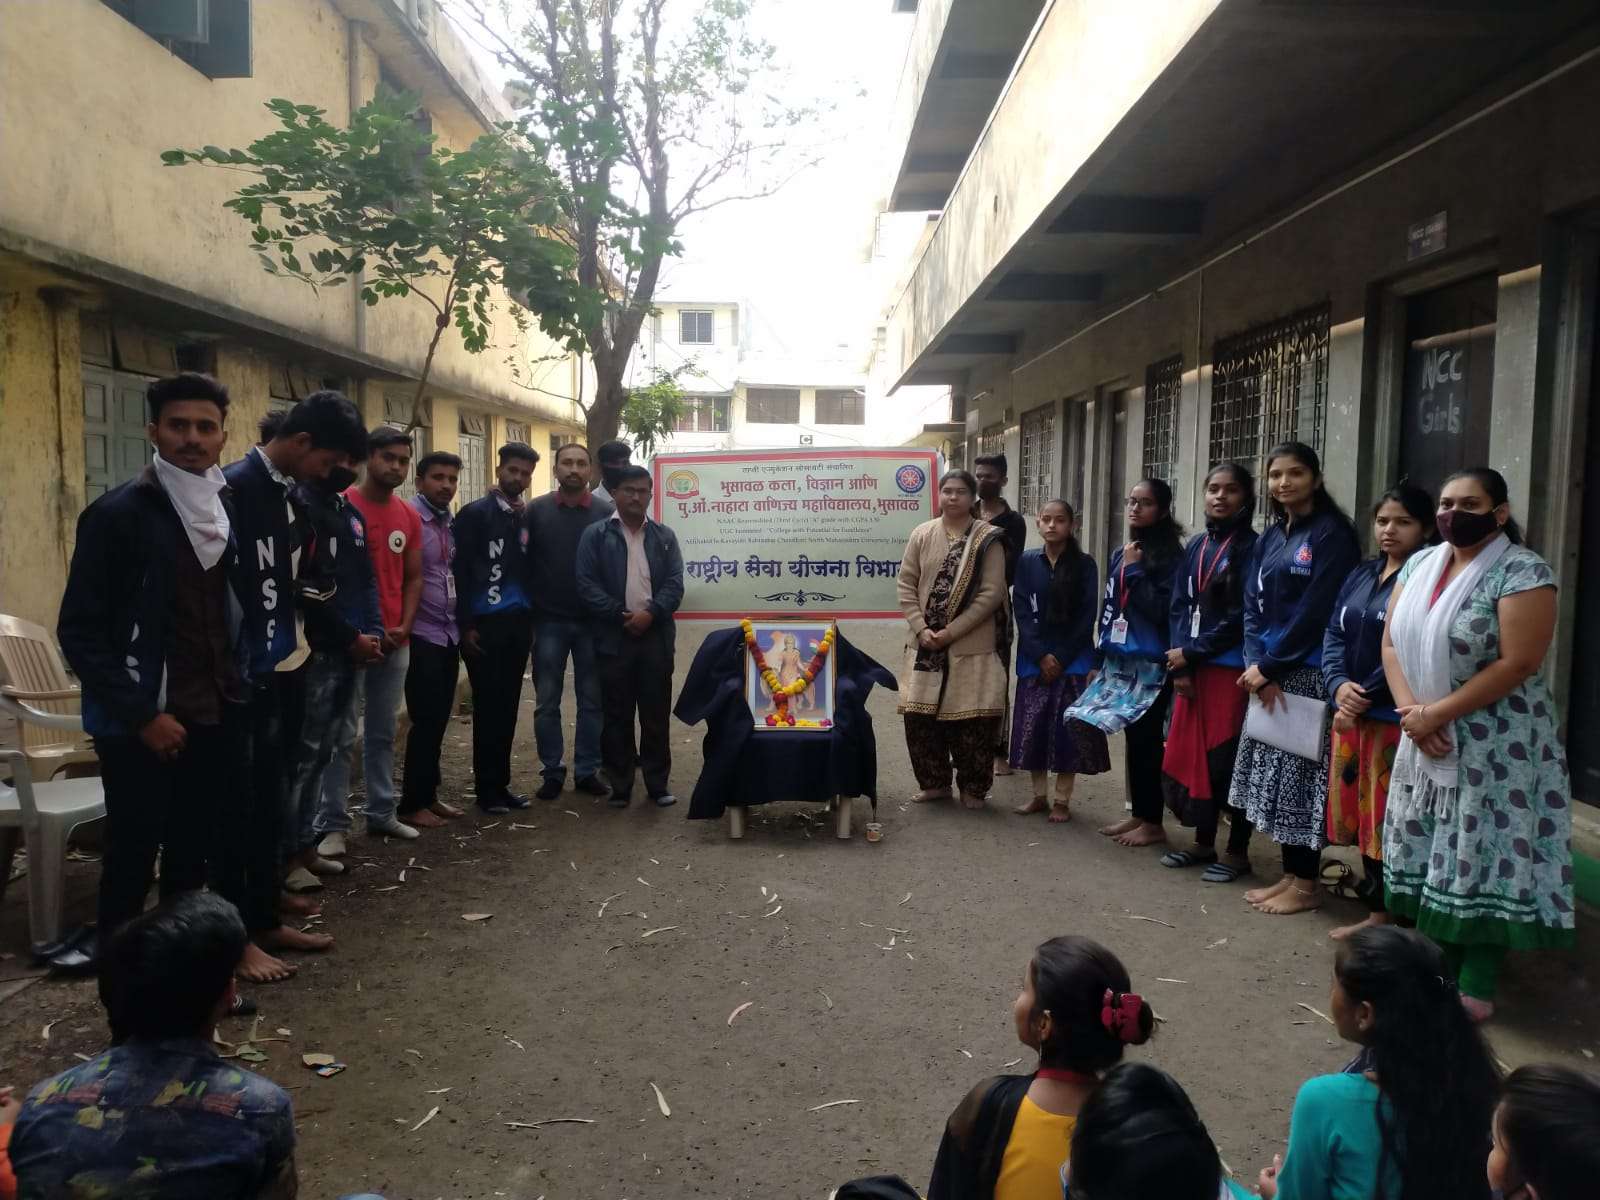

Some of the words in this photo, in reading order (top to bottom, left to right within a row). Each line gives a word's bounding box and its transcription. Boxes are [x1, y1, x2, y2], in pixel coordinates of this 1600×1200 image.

[1422, 348, 1463, 390] NCC
[1420, 392, 1462, 434] Girls
[720, 479, 765, 497] भुसावळ
[768, 478, 801, 493] कला,
[806, 475, 843, 490] विज्ञान
[848, 473, 878, 490] आणि
[753, 496, 798, 513] वाणिज्य
[487, 538, 505, 605] NSS
[687, 555, 738, 583] राष्ट्रीय
[745, 554, 782, 578] सेवा
[789, 554, 850, 578] योजना
[857, 555, 902, 578] विभा
